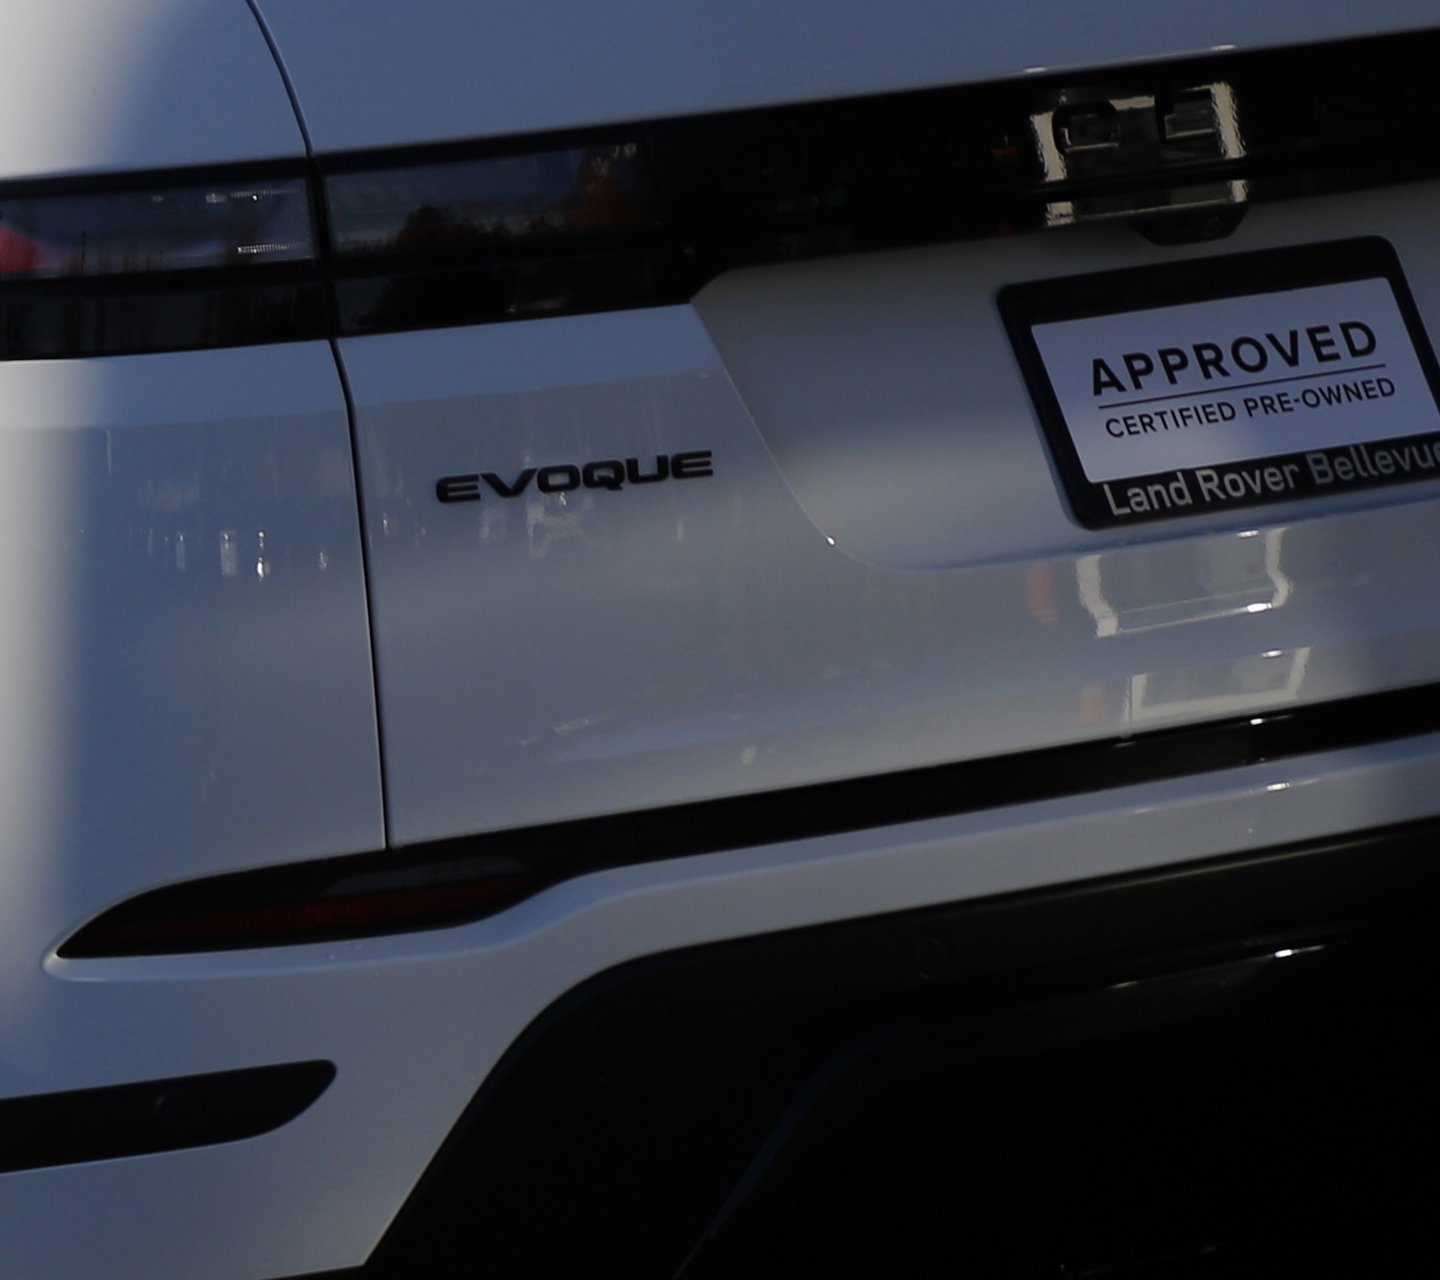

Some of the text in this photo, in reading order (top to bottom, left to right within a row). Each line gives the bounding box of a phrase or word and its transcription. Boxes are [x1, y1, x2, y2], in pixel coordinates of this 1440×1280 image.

[1091, 319, 1378, 397] APPROVED
[1105, 377, 1396, 439] CERTIFIED PRE-OWNED
[435, 450, 714, 503] EVOQUE
[1102, 470, 1194, 517] Land
[1201, 458, 1300, 502] Rover
